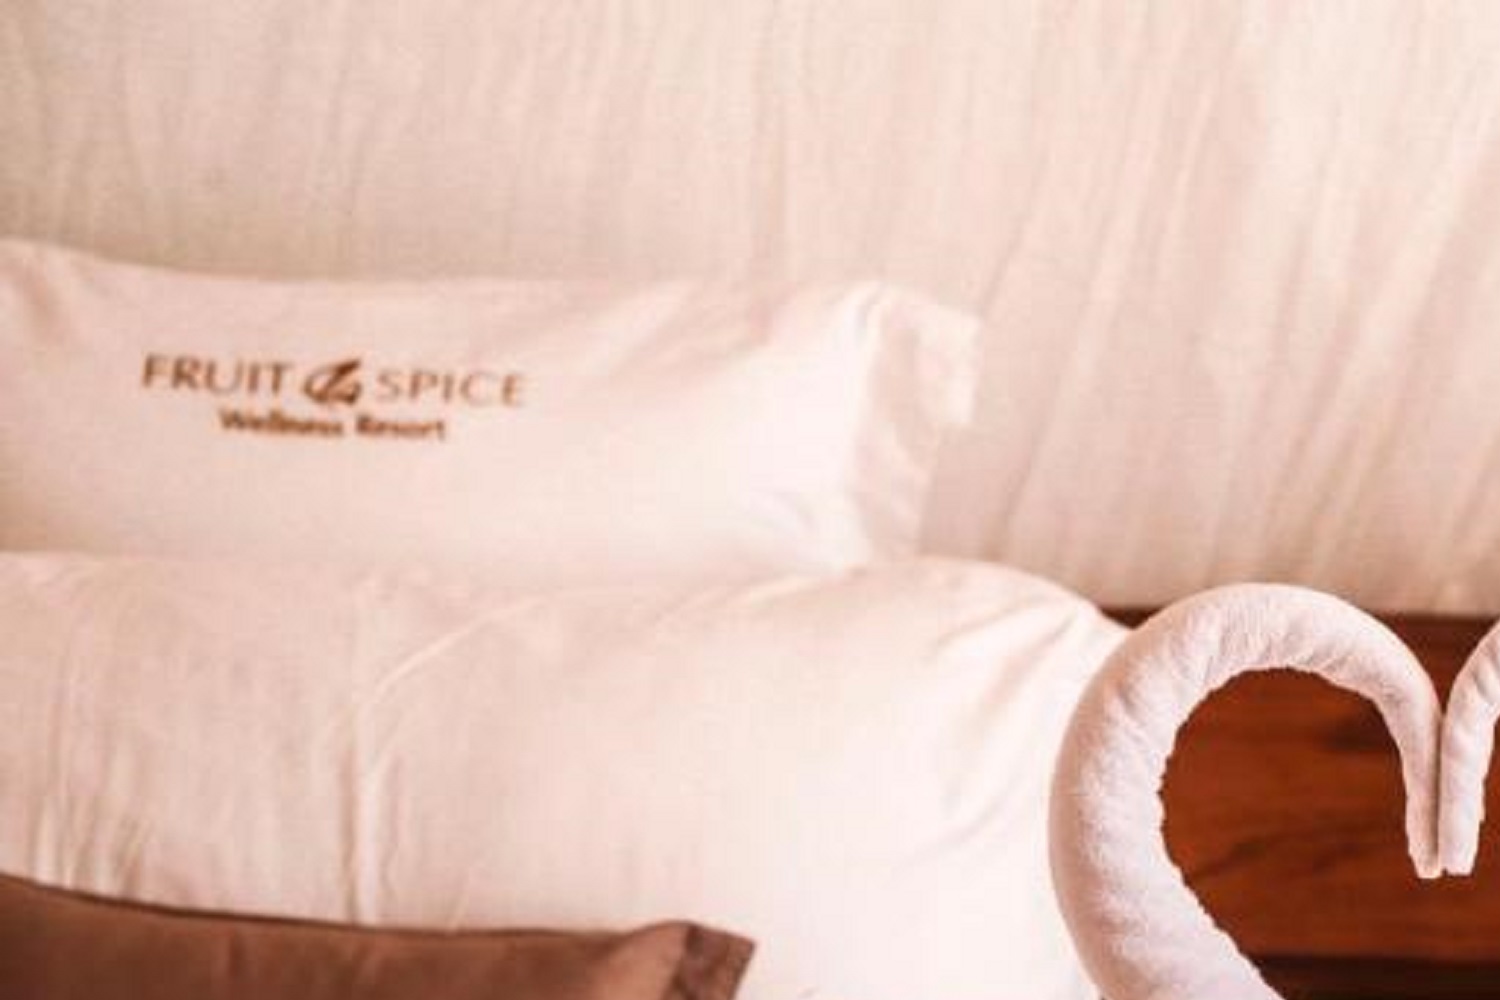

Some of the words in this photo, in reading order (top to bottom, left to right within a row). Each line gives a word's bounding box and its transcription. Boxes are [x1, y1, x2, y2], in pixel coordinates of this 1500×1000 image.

[142, 353, 288, 394] FRUIT
[376, 368, 527, 407] SPICE
[218, 408, 343, 438] Wellness
[355, 413, 446, 441] Resort
